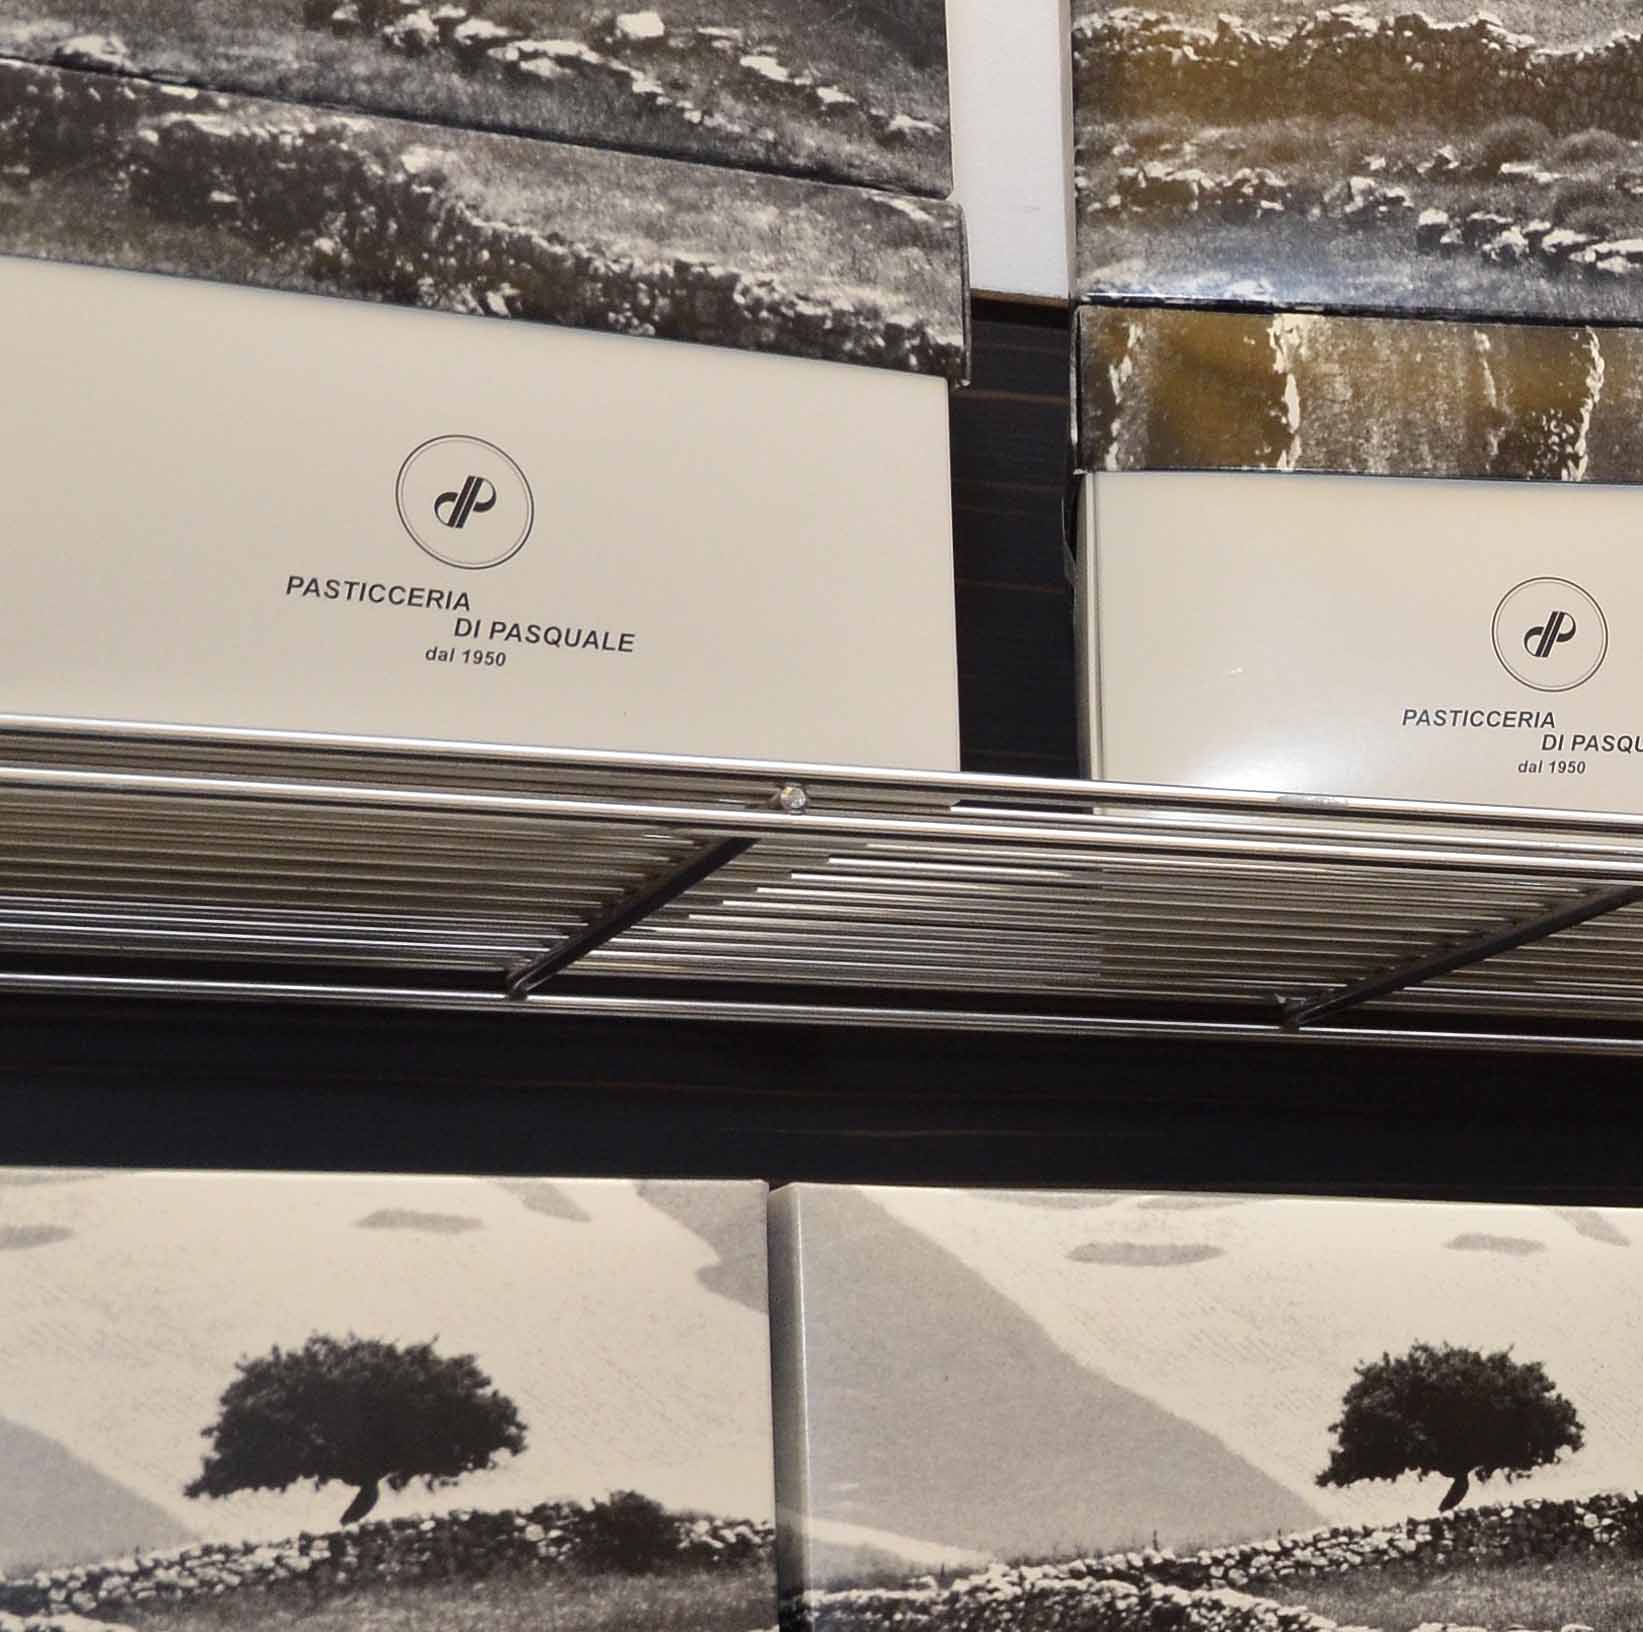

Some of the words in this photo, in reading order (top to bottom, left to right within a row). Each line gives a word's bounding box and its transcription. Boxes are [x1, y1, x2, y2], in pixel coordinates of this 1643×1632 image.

[285, 575, 471, 612] PASTICCERIA
[453, 618, 481, 639] DI
[488, 620, 636, 653] PASQUALE
[425, 646, 454, 664] dal
[462, 650, 507, 668] 1950
[1401, 709, 1556, 729] PASTICCERIA
[1541, 734, 1563, 752] DI
[1517, 760, 1543, 774] dal
[1549, 761, 1586, 774] 1950
